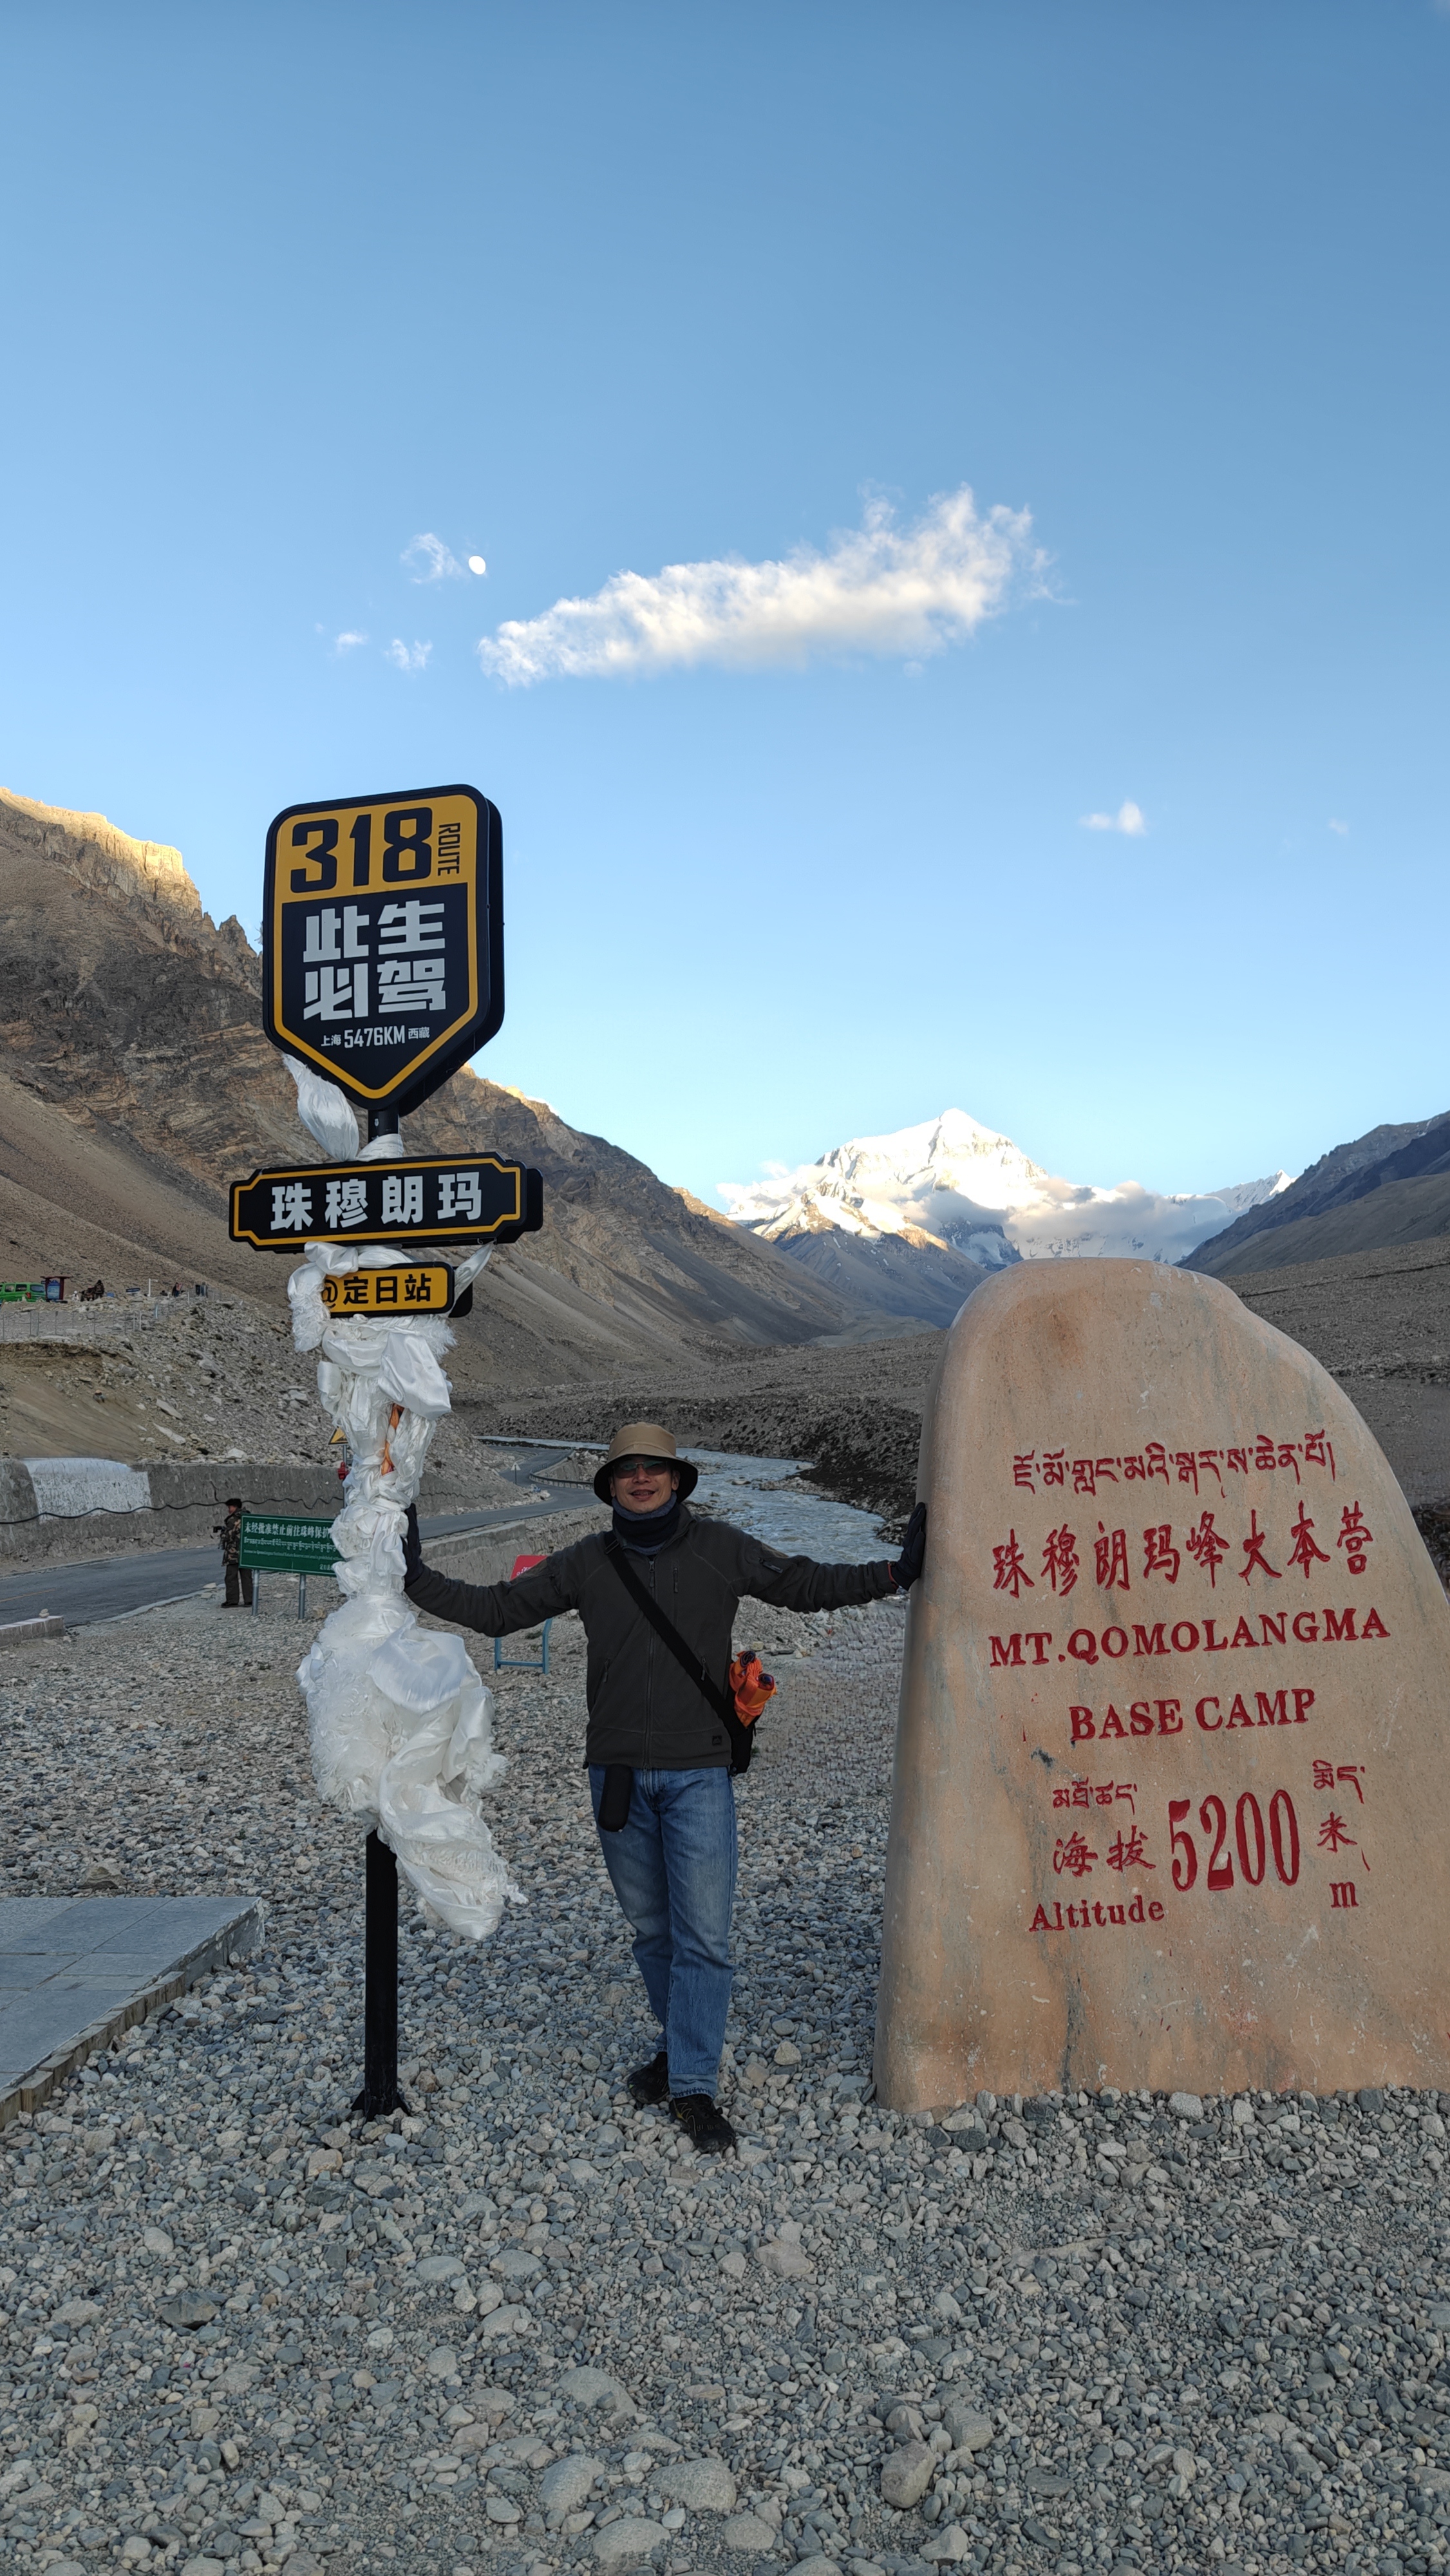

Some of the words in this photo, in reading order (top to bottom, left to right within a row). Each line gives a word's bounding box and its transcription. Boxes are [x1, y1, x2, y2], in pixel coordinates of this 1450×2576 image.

[290, 806, 433, 893] 318
[437, 822, 461, 876] ROUTE
[303, 900, 446, 963] 此生
[303, 958, 446, 1021] 必驾
[321, 1034, 341, 1046] 上海
[344, 1025, 406, 1048] 5476KM
[408, 1027, 430, 1039] 西藏
[270, 1171, 482, 1231] 珠穆朗玛
[244, 1521, 332, 1539] 未经批准禁止前往珠峰保护
[992, 1501, 1373, 1599] 珠穆朗玛峰大本营
[1068, 1698, 1183, 1741] BASE
[1194, 1689, 1315, 1731] CAMP
[1053, 1824, 1156, 1877] 海拔
[1168, 1789, 1300, 1892] 5200
[1317, 1812, 1358, 1853] 米
[1028, 1894, 1165, 1933] Altitude
[1329, 1881, 1359, 1908] m
